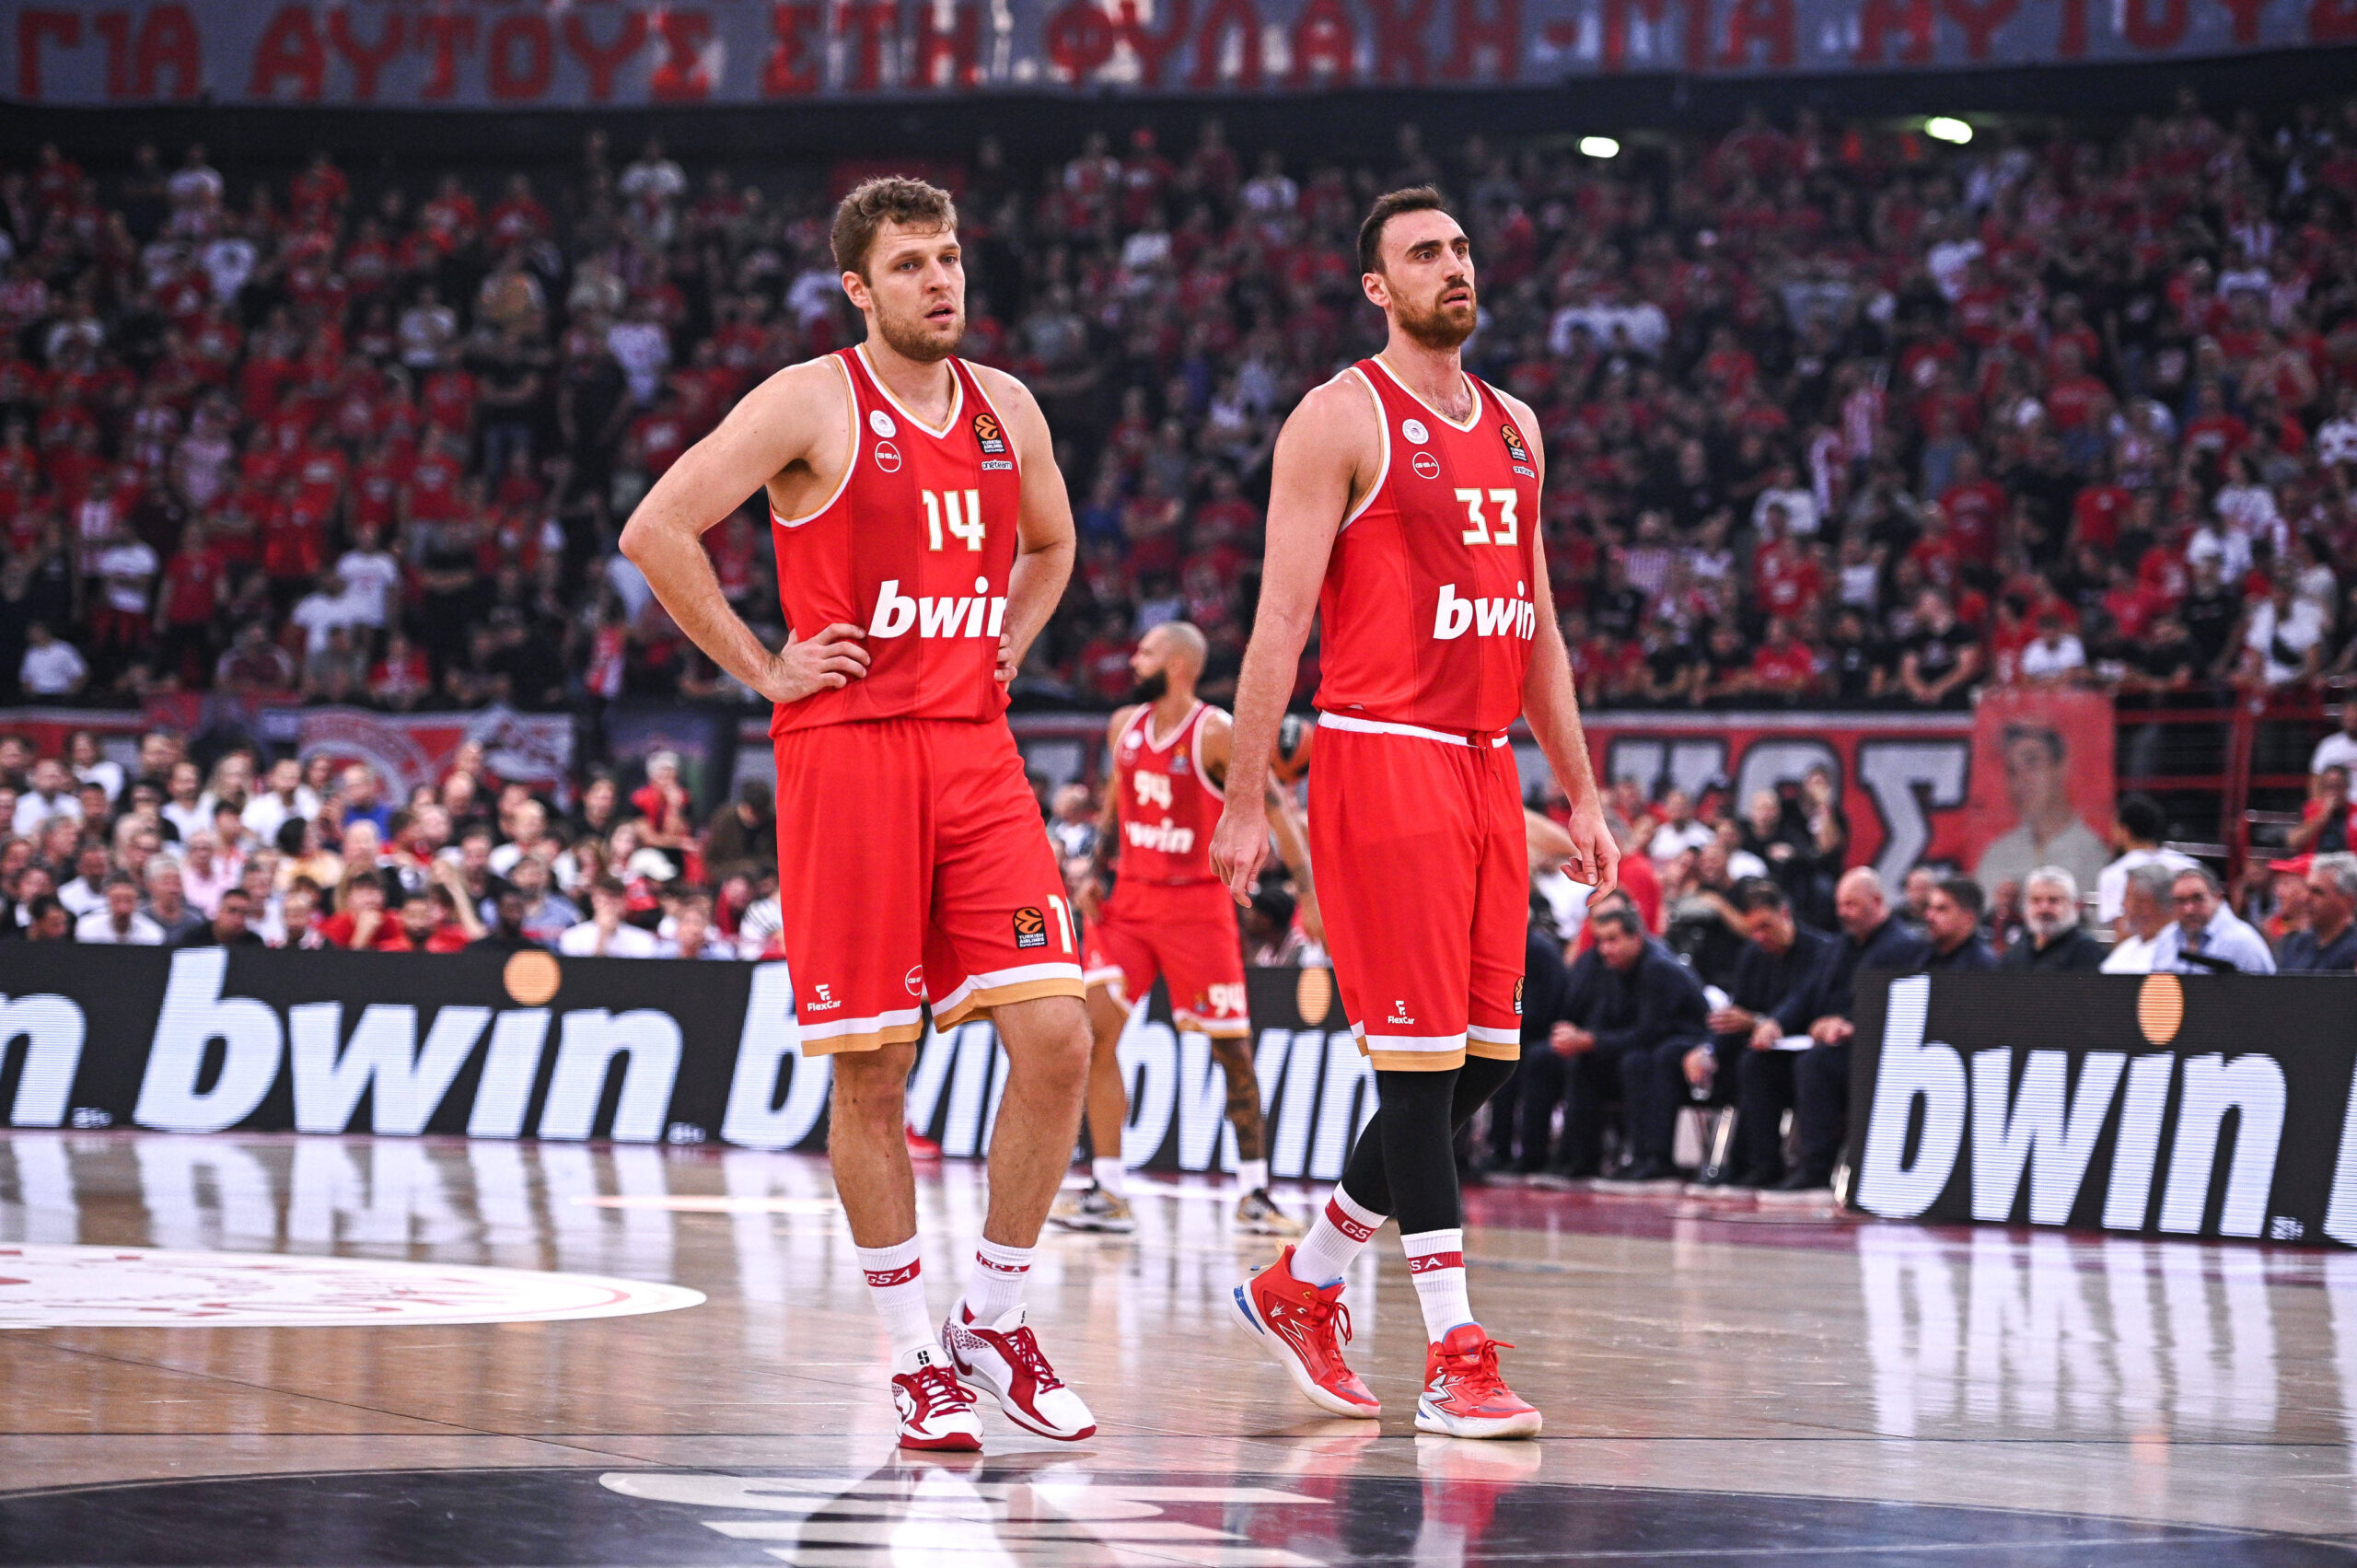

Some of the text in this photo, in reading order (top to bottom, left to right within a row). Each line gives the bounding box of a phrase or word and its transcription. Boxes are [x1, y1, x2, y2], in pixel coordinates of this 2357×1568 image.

[922, 489, 986, 552] 14
[1454, 487, 1518, 546] 33
[1433, 580, 1536, 641] bwin
[1134, 770, 1173, 810] 94
[1124, 817, 1195, 854] win
[1047, 894, 1078, 955] 1
[807, 1000, 842, 1012] FlexCar
[1208, 983, 1248, 1018] 94
[1387, 1016, 1415, 1025] FlexCar
[133, 947, 683, 1143] bwin
[1855, 972, 2287, 1239] bwin
[1341, 1220, 1371, 1239] GS
[865, 1268, 911, 1285] GSA
